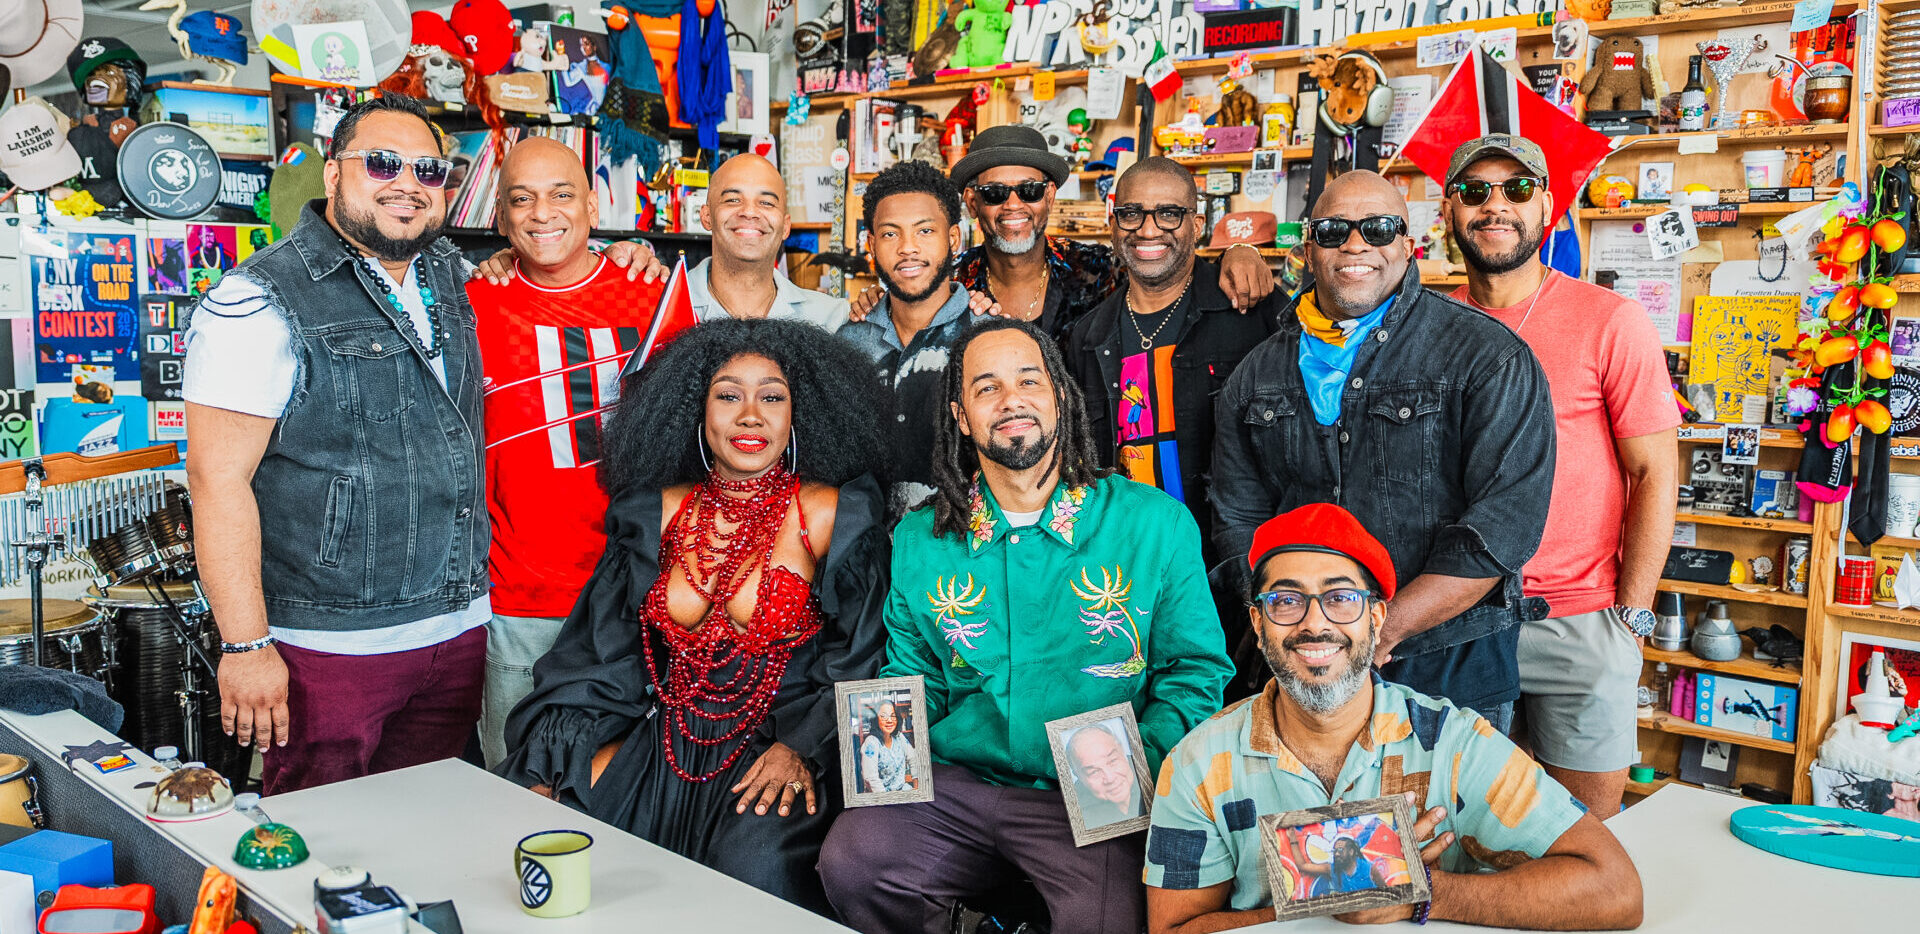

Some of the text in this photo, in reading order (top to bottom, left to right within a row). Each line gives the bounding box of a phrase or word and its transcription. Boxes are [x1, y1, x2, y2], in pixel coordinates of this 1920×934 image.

[1204, 20, 1282, 47] RECORDING
[1538, 69, 1559, 77] YOUR
[24, 125, 41, 138] AM
[7, 128, 55, 151] LAKSHMI
[20, 140, 53, 157] SINGH
[221, 171, 266, 194] NIGHT
[220, 191, 255, 206] AMERI
[1693, 210, 1720, 223] SWING
[1721, 209, 1739, 222] OUT
[92, 263, 134, 283] ON THE
[97, 281, 130, 301] ROAD
[39, 311, 117, 338] CONTEST
[117, 312, 131, 324] 20
[118, 324, 131, 337] 25
[158, 411, 184, 420] NPR
[83, 438, 114, 453] JAZZ
[1827, 445, 1845, 485] ONCERTS
[1692, 479, 1717, 488] FUZZ
[42, 568, 95, 584] ORKIN
